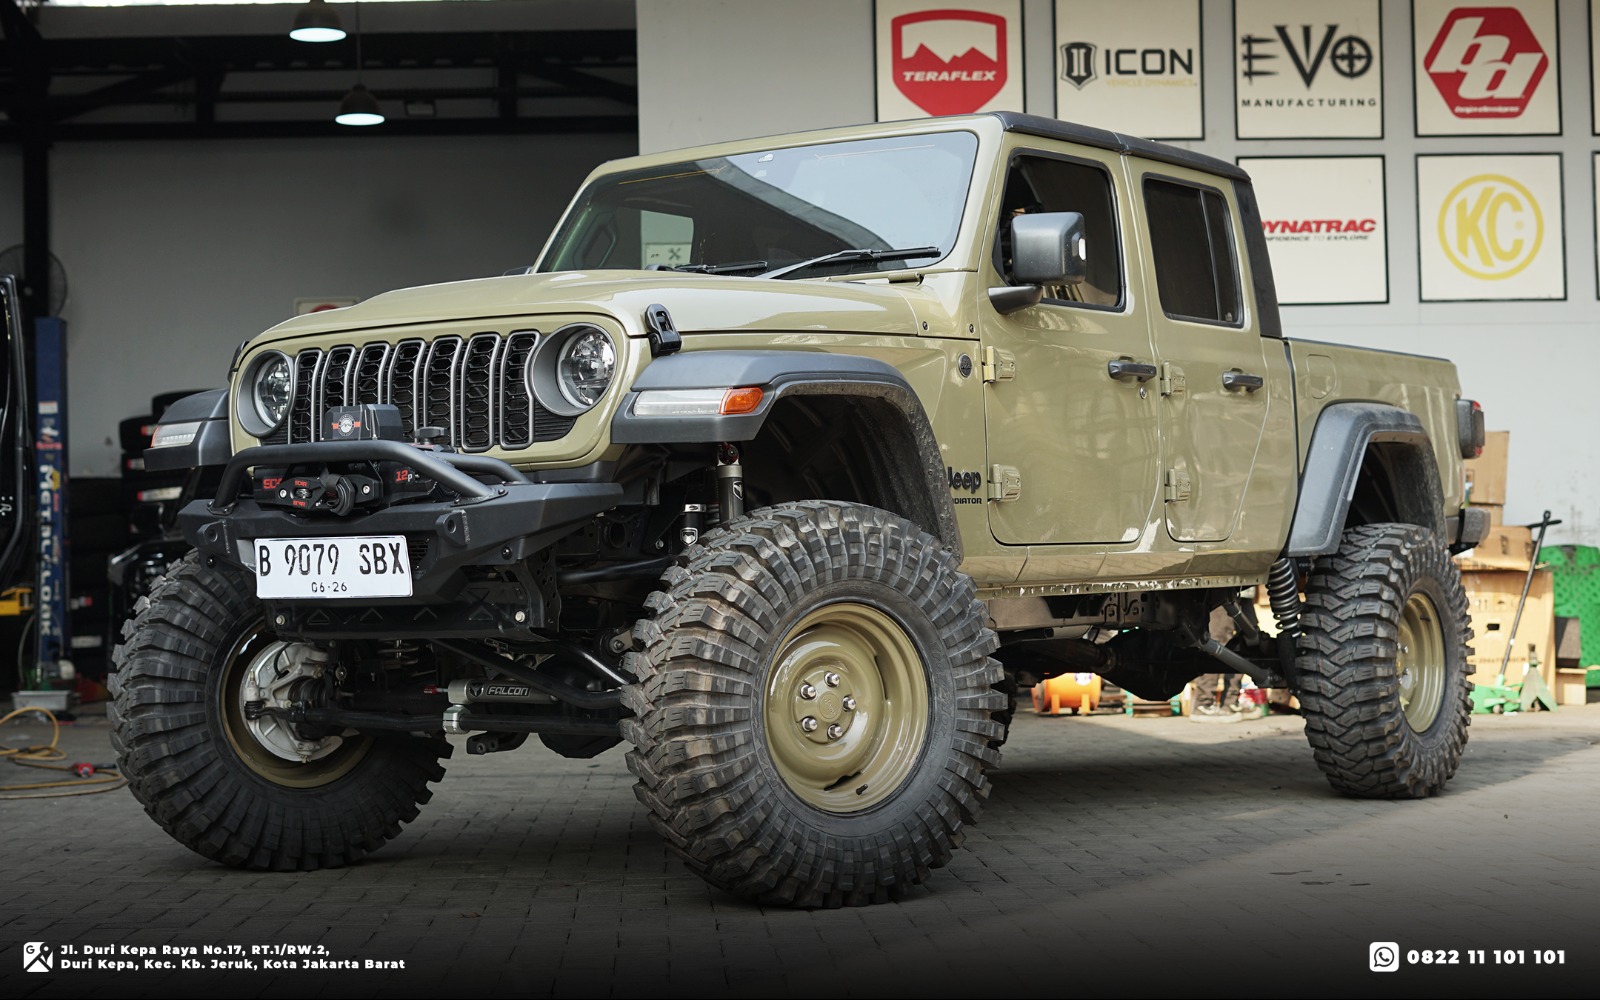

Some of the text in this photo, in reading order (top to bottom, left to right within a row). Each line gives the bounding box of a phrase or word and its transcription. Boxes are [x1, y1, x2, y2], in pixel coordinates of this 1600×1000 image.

[1105, 48, 1193, 76] ICON
[903, 70, 998, 83] TERAFLEX
[1105, 78, 1142, 87] VEHICLE
[1242, 99, 1377, 107] MANUFACTURING
[1456, 187, 1524, 268] KC
[947, 466, 981, 494] Jeep
[259, 542, 405, 577] B 9079 SBX
[488, 686, 529, 696] FALCON
